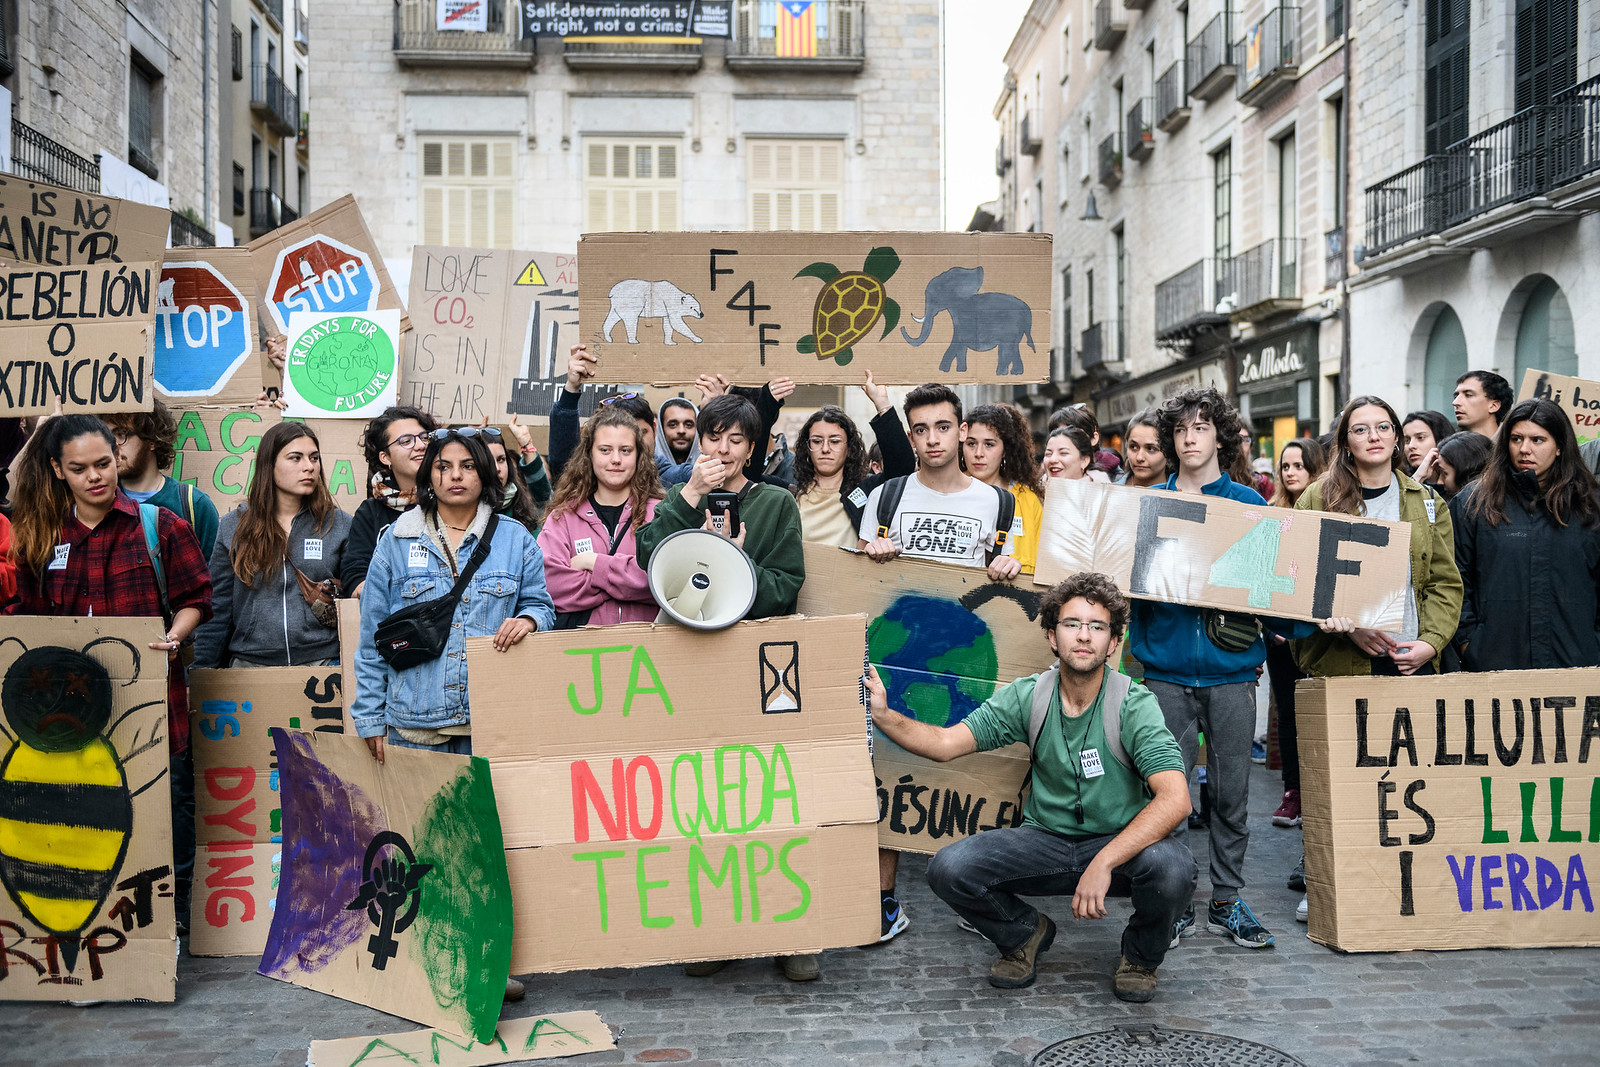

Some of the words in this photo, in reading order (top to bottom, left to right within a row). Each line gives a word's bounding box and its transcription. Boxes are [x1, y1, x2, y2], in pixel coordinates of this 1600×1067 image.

[526, 2, 670, 18] Self-determination
[675, 4, 688, 18] is
[530, 21, 541, 32] a
[546, 18, 588, 36] right,
[594, 19, 620, 32] not
[625, 21, 635, 32] a
[640, 18, 684, 32] crime
[74, 198, 112, 230] NO
[283, 260, 360, 312] STOP
[425, 254, 493, 294] LOVE
[47, 323, 75, 357] O
[292, 319, 340, 366] FRIDAYS
[351, 318, 378, 339] FOR
[413, 333, 437, 373] IS
[456, 336, 488, 376] IN
[1240, 353, 1259, 383] La
[1258, 341, 1303, 378] Moda
[334, 371, 391, 410] FUTURE
[408, 381, 446, 418] THE
[449, 384, 485, 420] AIR
[908, 517, 958, 535] JACK
[564, 645, 674, 717] JA
[1081, 752, 1098, 760] MAKE
[1083, 759, 1100, 768] LOVE
[570, 755, 663, 843] NO
[670, 743, 799, 845] QUEDA
[1377, 770, 1436, 847] ÉS
[203, 766, 257, 928] DYING
[572, 836, 812, 933] TEMPS
[1446, 853, 1594, 913] VERDA
